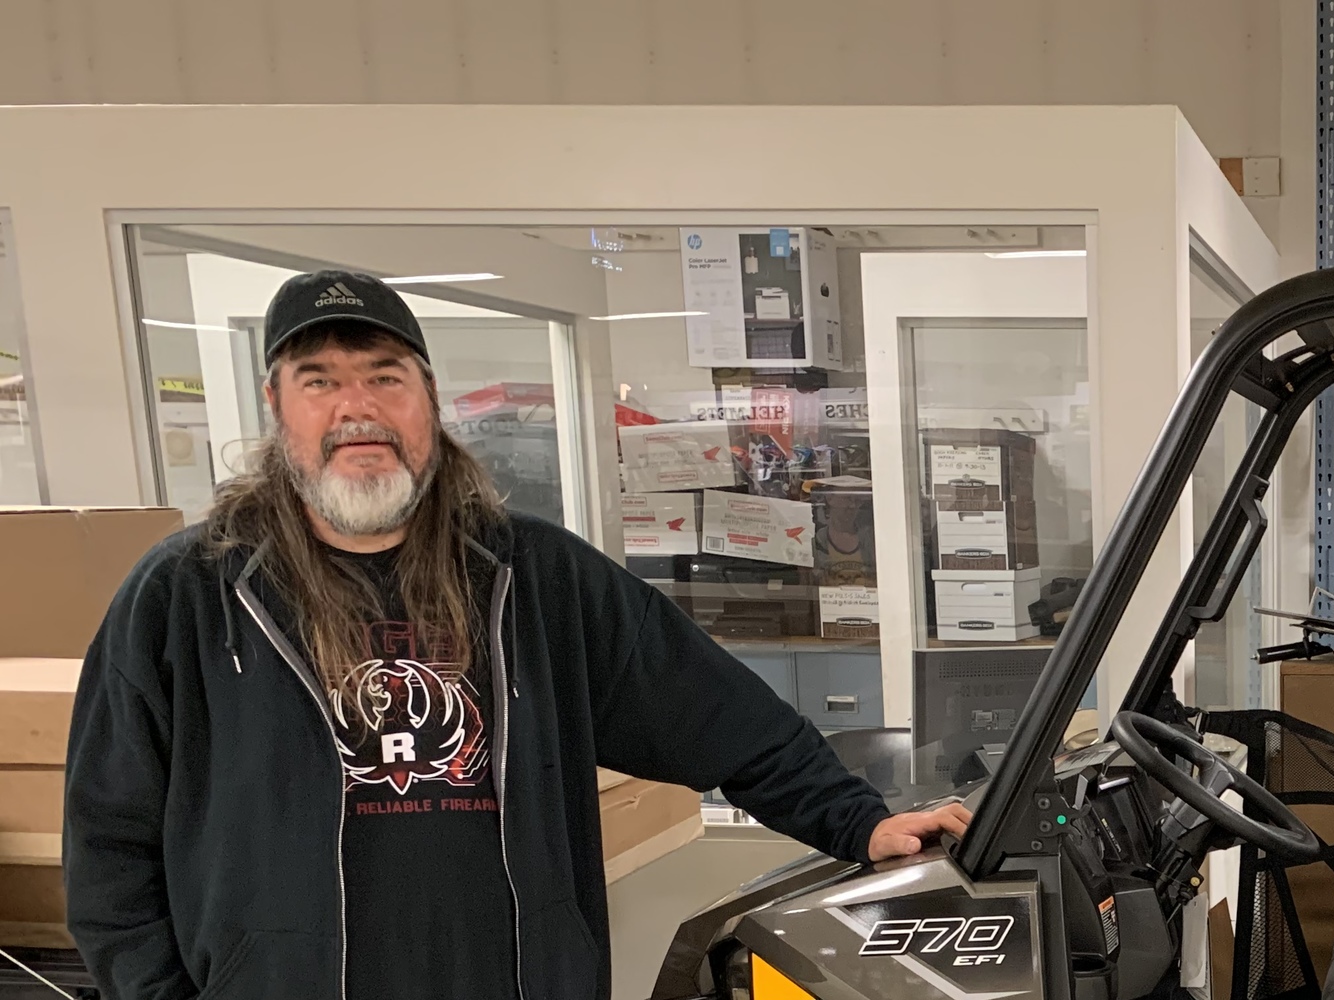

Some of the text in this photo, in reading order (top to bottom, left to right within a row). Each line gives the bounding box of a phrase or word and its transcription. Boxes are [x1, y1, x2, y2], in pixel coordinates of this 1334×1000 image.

[687, 234, 702, 250] hp
[314, 296, 364, 308] adidas
[380, 731, 416, 764] R
[356, 798, 499, 815] RELIABLE FIREAR
[857, 915, 1015, 955] 570
[952, 954, 1006, 967] EFI
